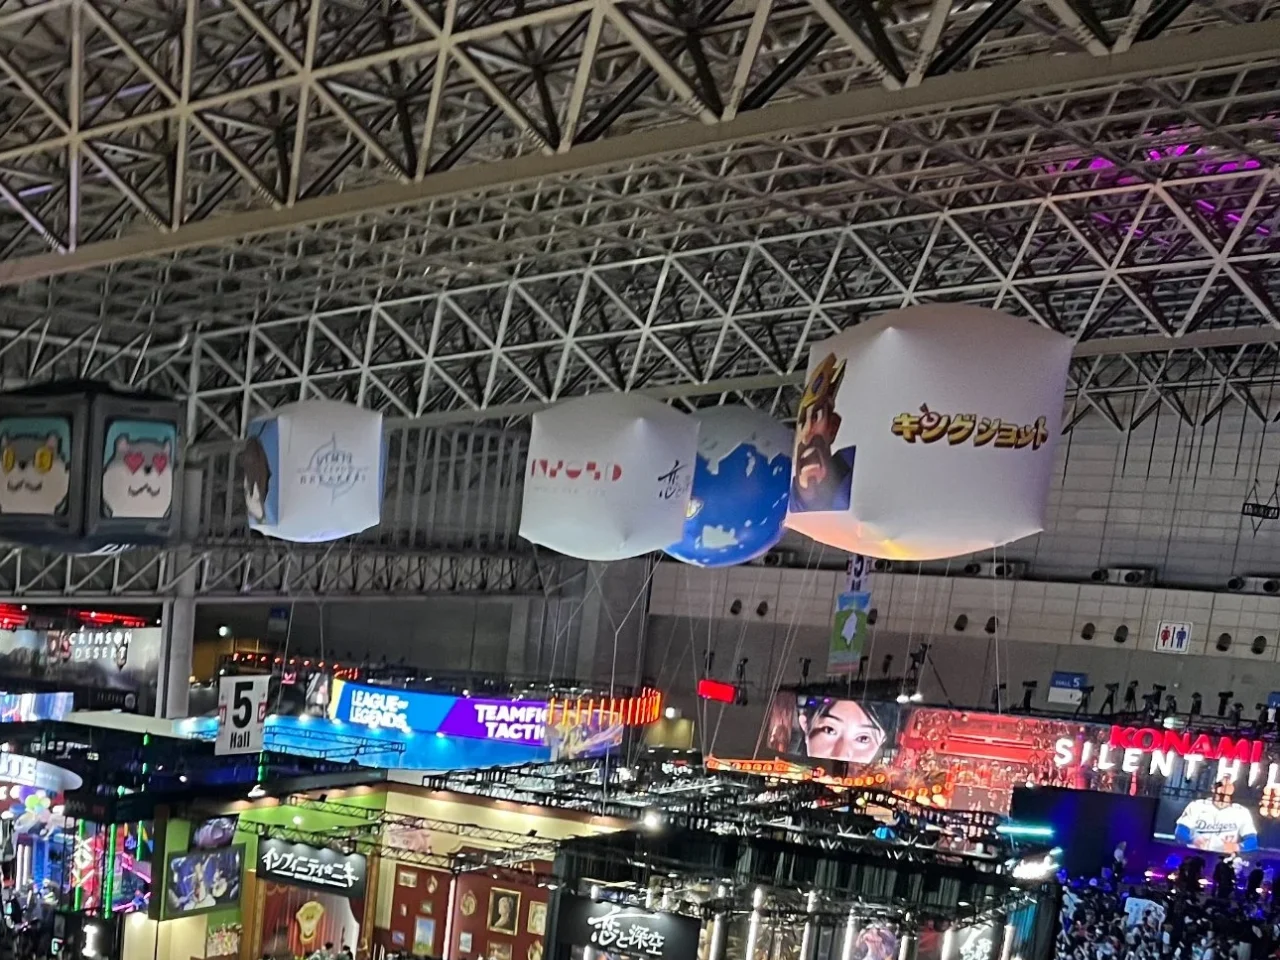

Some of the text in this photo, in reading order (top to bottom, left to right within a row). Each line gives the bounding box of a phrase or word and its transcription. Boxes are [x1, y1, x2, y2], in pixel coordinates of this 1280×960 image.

[891, 408, 1048, 450] キングショット
[69, 631, 133, 645] CRIMSON
[75, 646, 127, 659] DESERT
[1072, 676, 1081, 688] 5
[232, 681, 254, 729] 5
[351, 689, 399, 712] LEAGUE
[349, 706, 406, 729] LEGENDS
[229, 731, 250, 749] Hall
[1109, 724, 1264, 764] KONAMI
[1053, 737, 1205, 781] SILENT
[1195, 818, 1238, 835] Dodgers
[587, 904, 665, 955] 恋と深空
